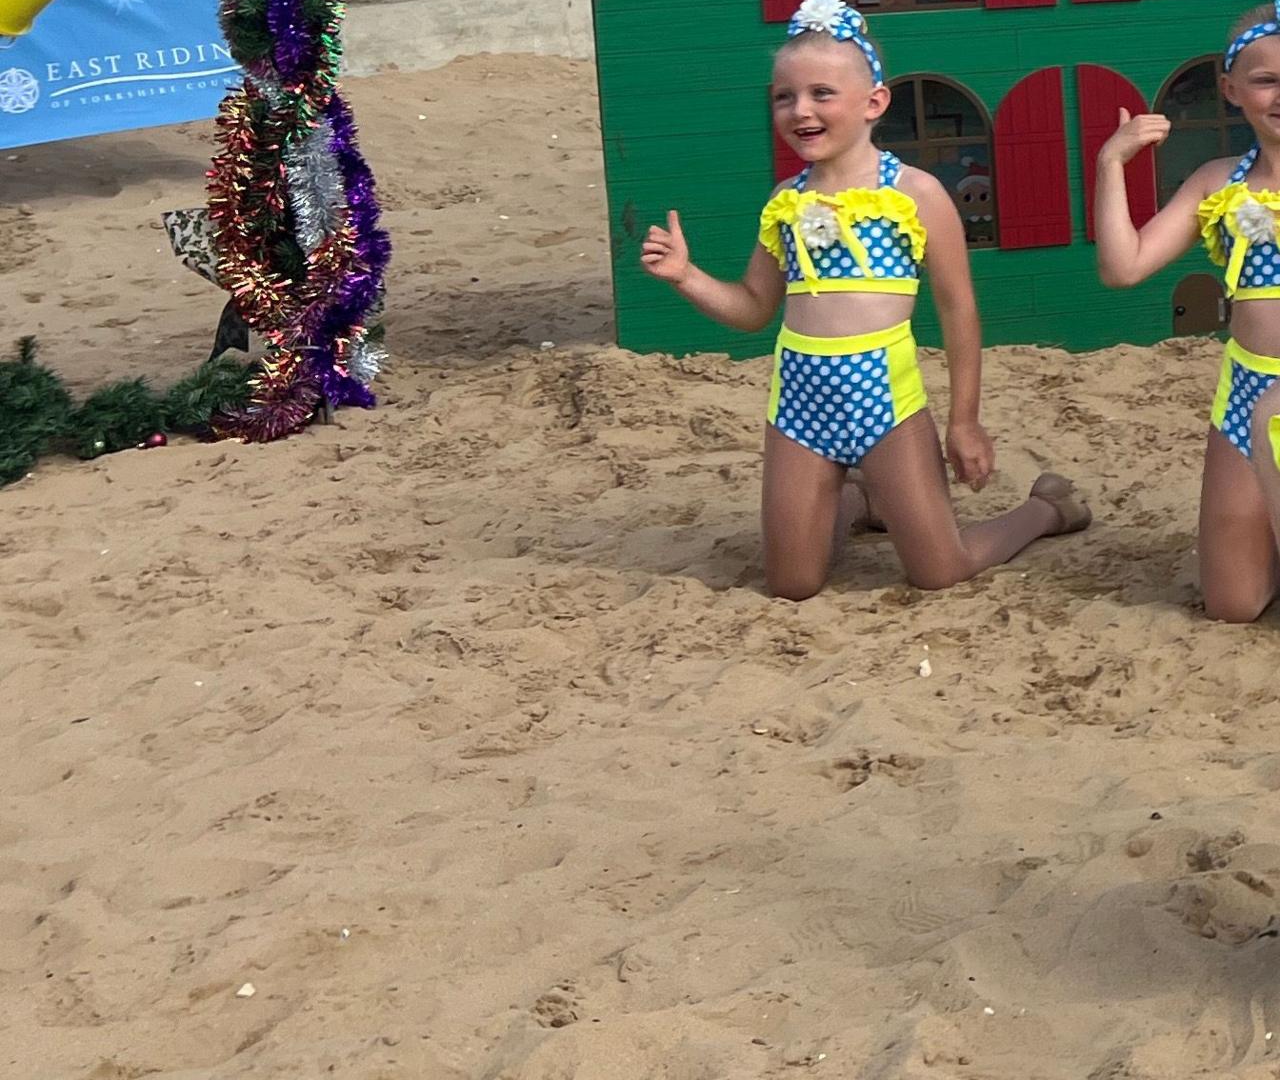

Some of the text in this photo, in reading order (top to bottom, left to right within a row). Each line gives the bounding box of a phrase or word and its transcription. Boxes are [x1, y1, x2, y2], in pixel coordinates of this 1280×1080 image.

[46, 42, 233, 82] EAST RIDIN
[50, 76, 245, 109] OF YORKSHIRE COUNC
